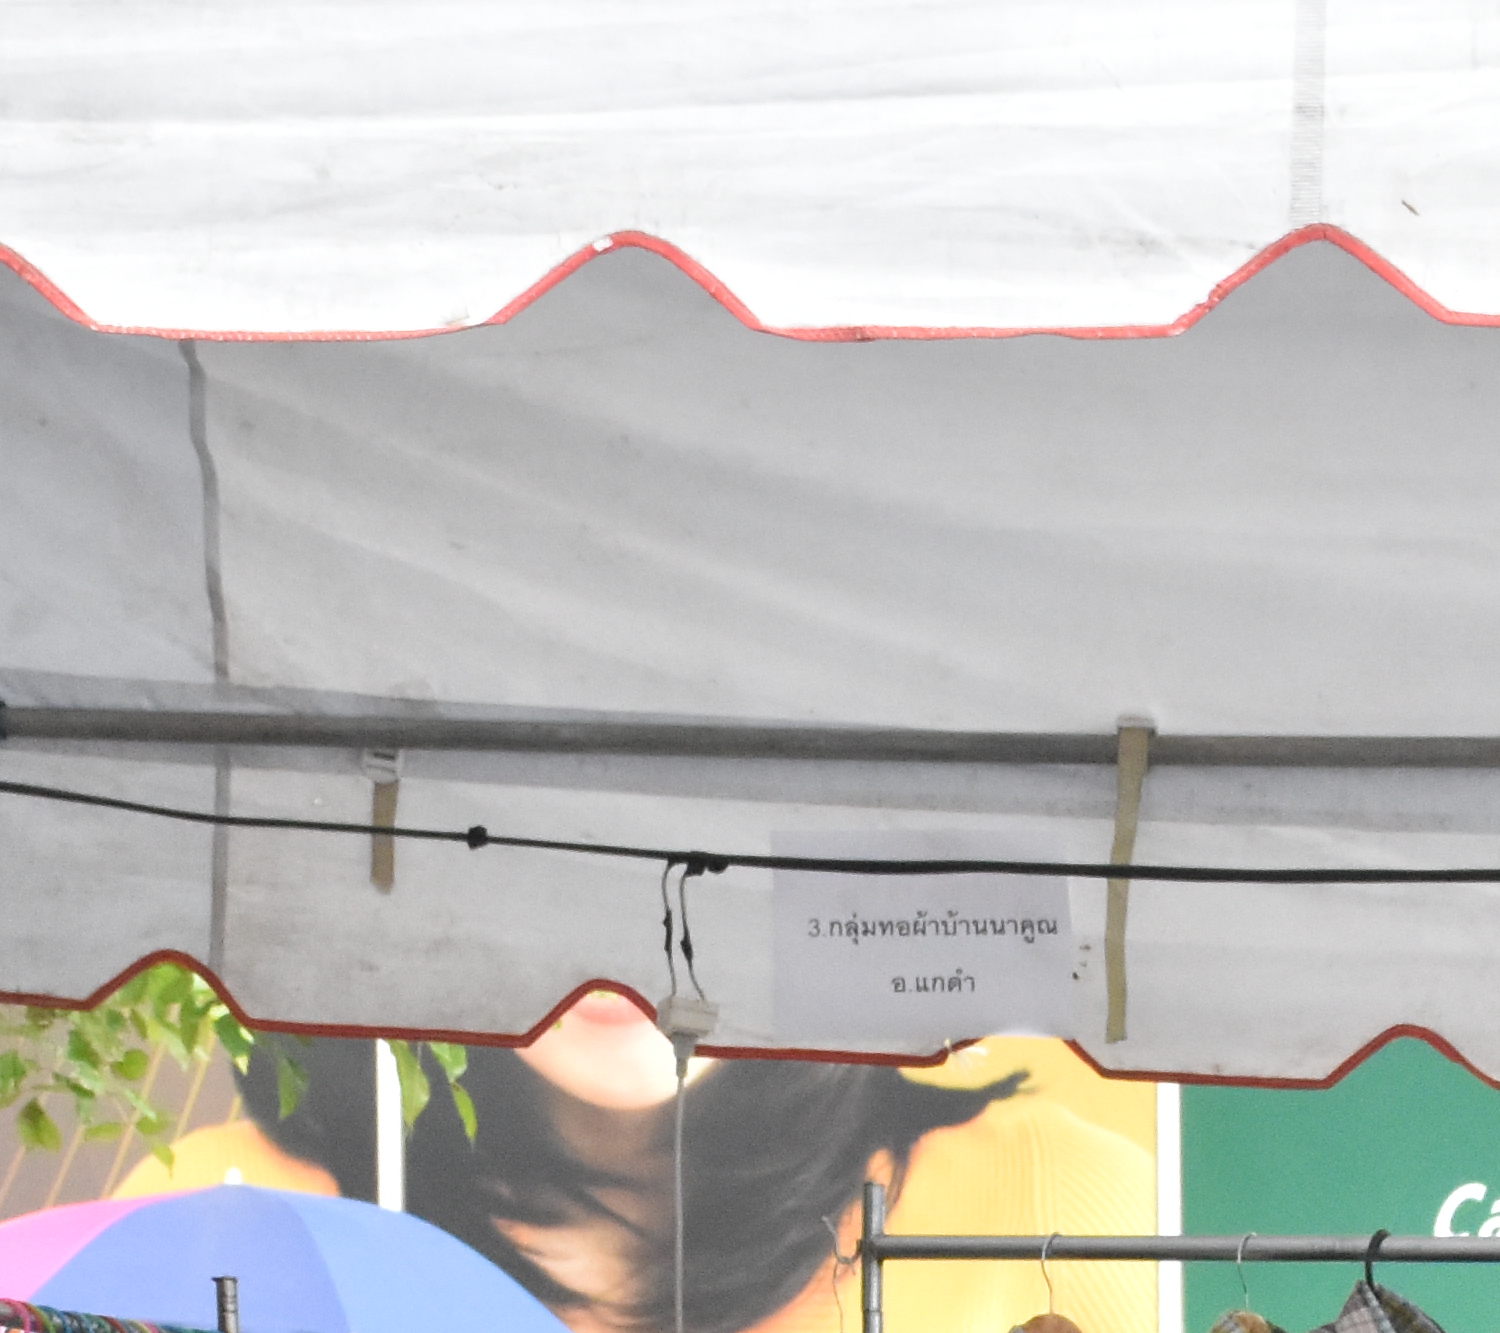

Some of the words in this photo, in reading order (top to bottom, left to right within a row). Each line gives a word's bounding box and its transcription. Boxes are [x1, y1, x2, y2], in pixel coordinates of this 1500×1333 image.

[807, 910, 1059, 945] 3.กลุ่มทอผ้าบ้านนาคูณ
[890, 968, 976, 993] อ.แกดำ
